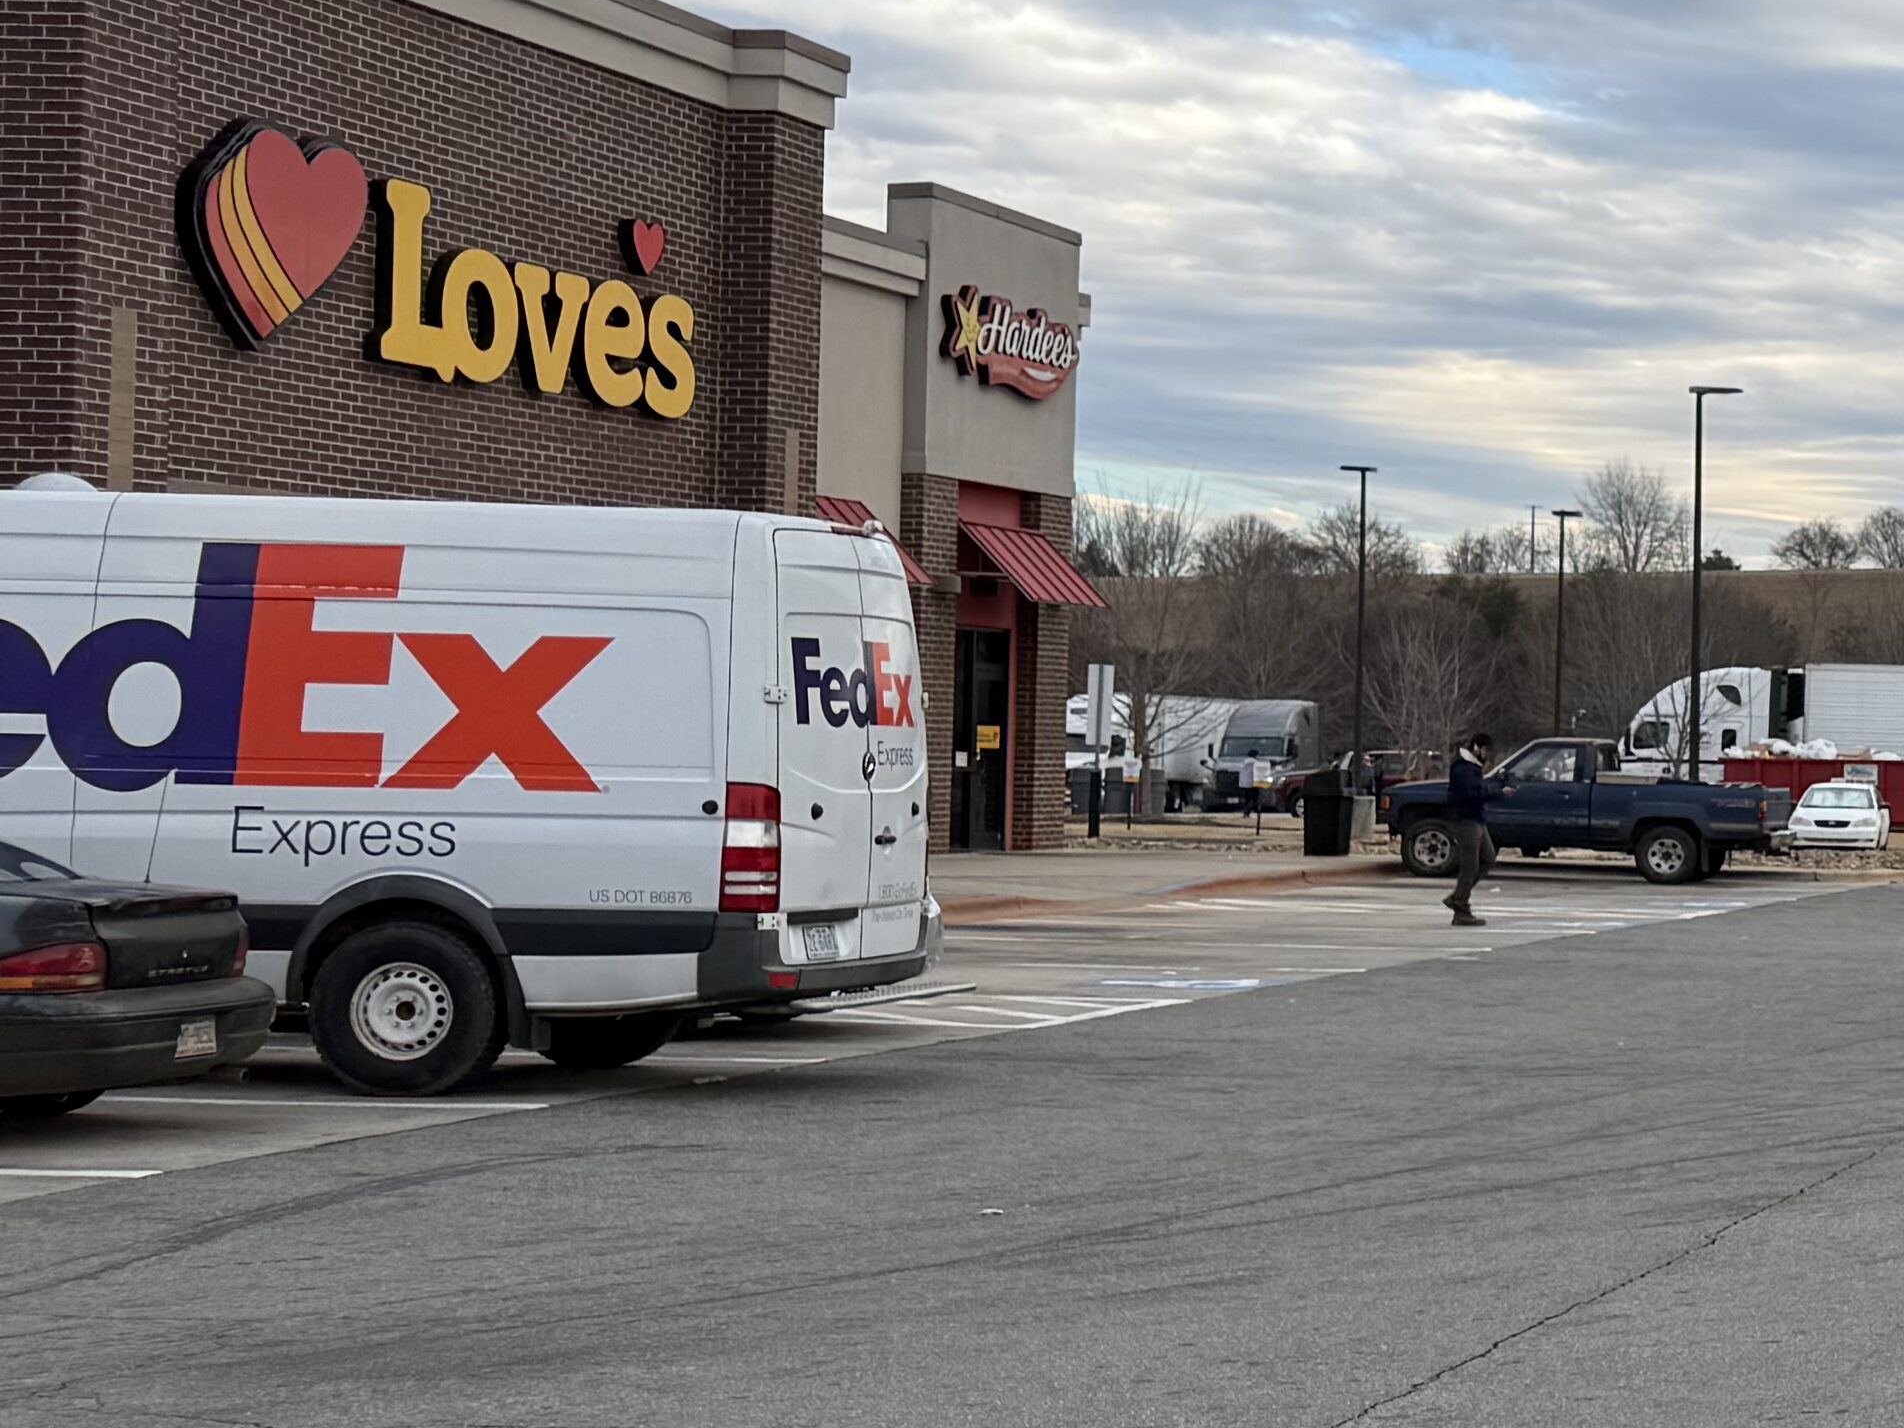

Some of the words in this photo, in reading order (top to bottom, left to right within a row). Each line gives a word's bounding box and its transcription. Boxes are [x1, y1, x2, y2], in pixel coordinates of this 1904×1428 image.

[791, 636, 915, 729] FedEx
[876, 740, 914, 772] Express
[230, 805, 458, 868] Express
[589, 889, 610, 903] US
[614, 889, 646, 904] DOT
